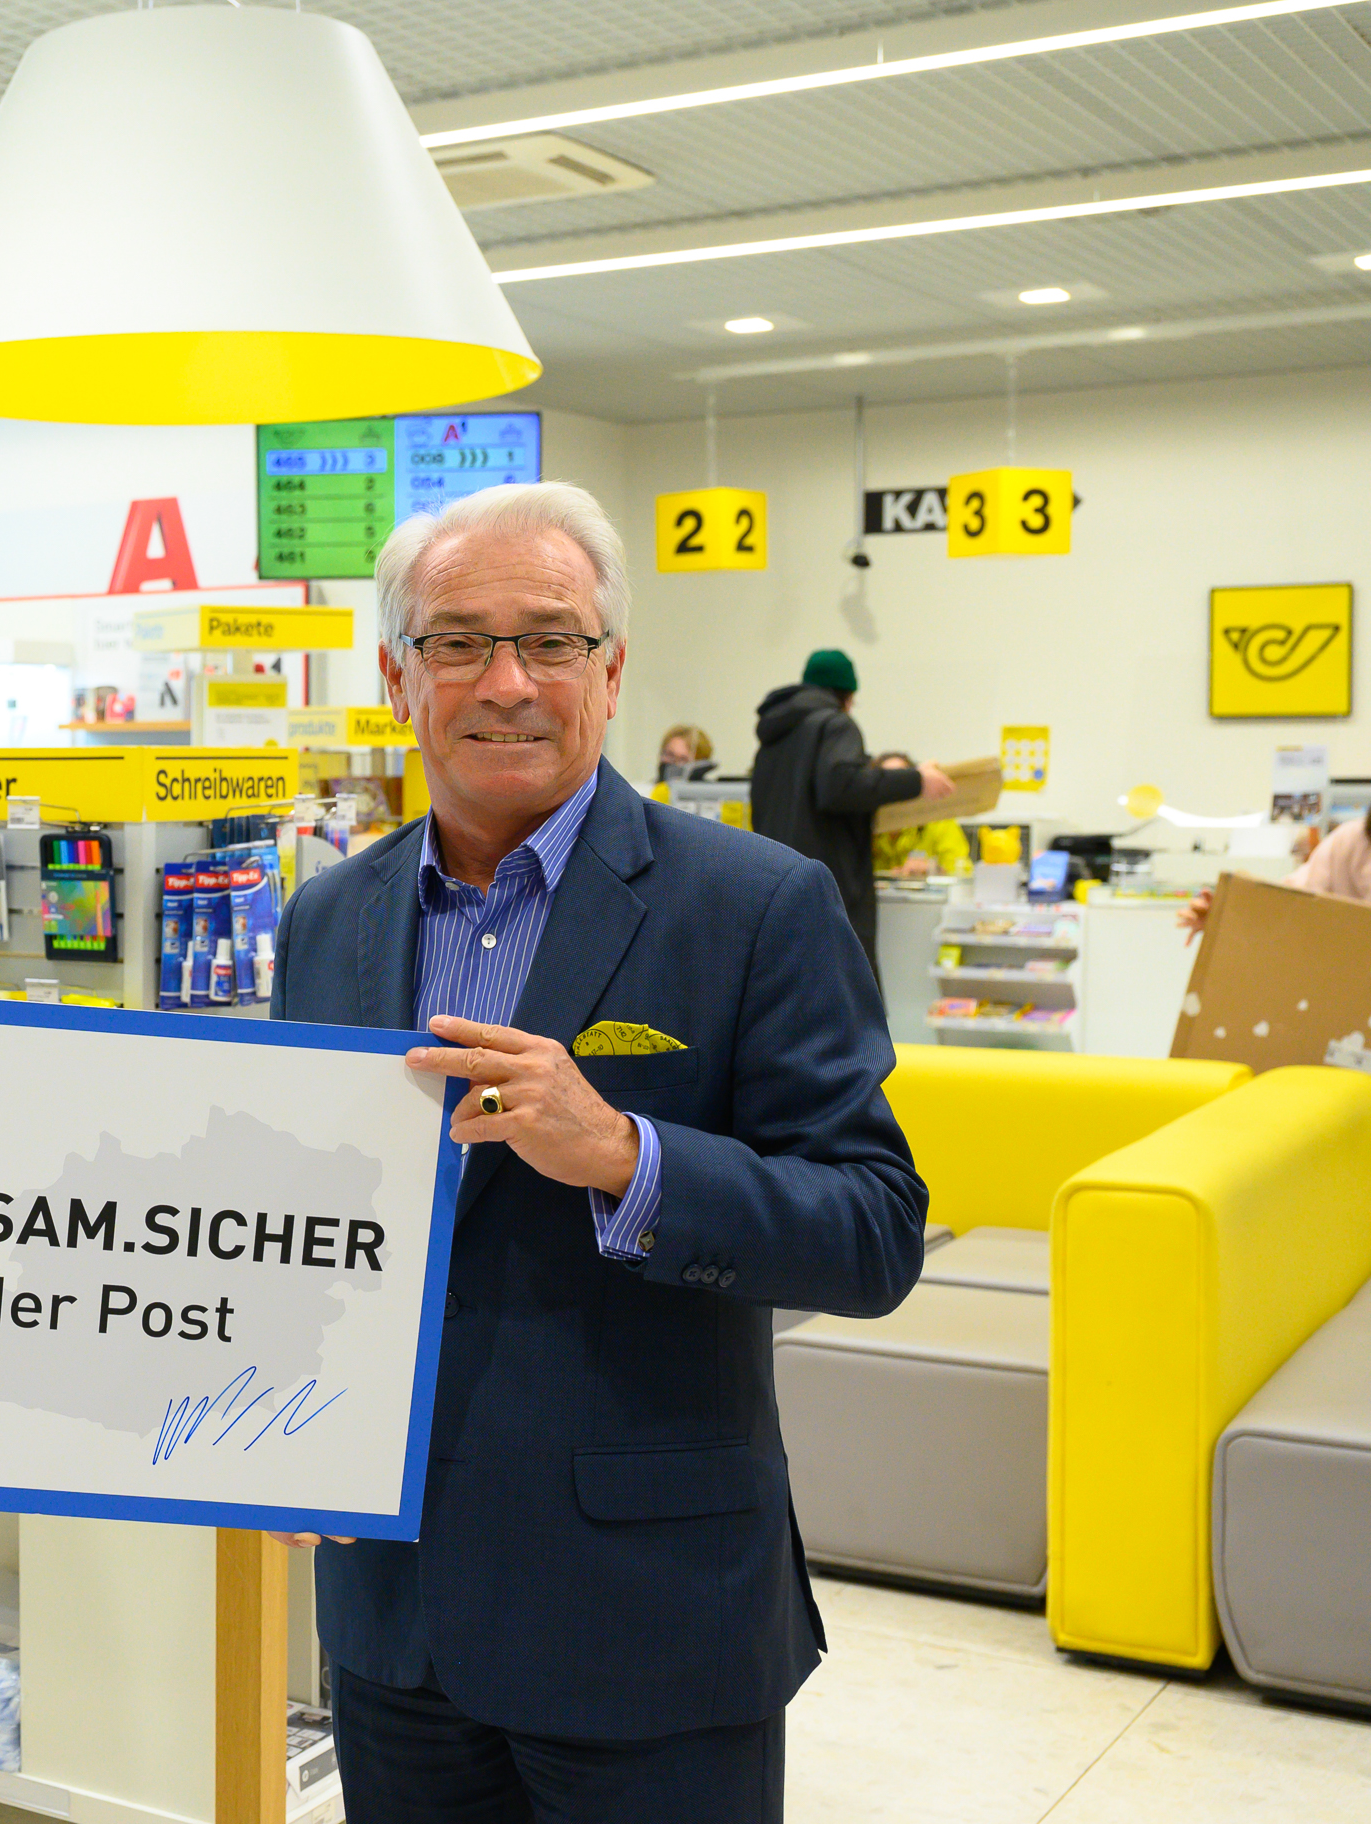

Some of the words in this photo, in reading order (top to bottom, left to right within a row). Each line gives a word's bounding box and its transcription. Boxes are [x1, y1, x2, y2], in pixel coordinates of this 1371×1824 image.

[674, 508, 706, 555] 2
[735, 508, 756, 552] 2
[963, 491, 986, 538] 3
[1020, 488, 1052, 535] 3
[208, 617, 275, 638] Pakete
[155, 768, 287, 802] Schreibwaren
[98, 1284, 236, 1343] Post
